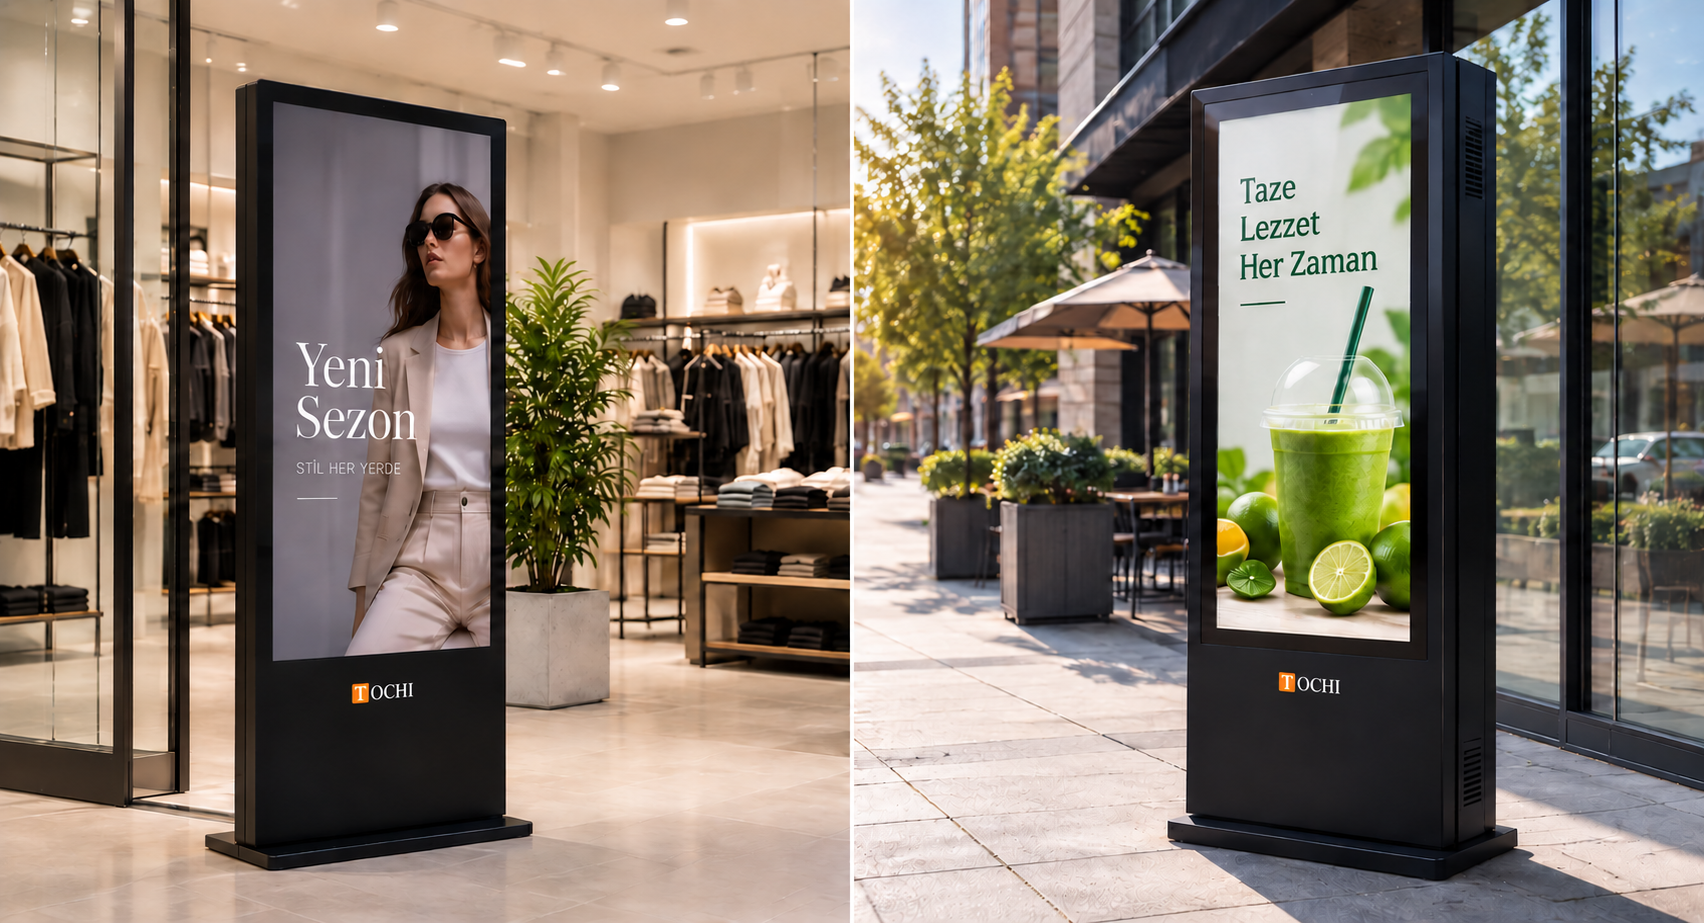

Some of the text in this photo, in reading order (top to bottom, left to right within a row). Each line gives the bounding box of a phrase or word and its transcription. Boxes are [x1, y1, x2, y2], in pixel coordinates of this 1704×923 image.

[1240, 177, 1296, 204] Taze
[1240, 211, 1321, 242] Lezzet
[1240, 250, 1378, 280] Her Zaman
[296, 341, 386, 389] Yeni
[296, 395, 417, 440] Sezon
[296, 459, 401, 475] STİL HER YERDE
[354, 682, 414, 701] TOCHI
[1281, 674, 1340, 695] TOCHI
